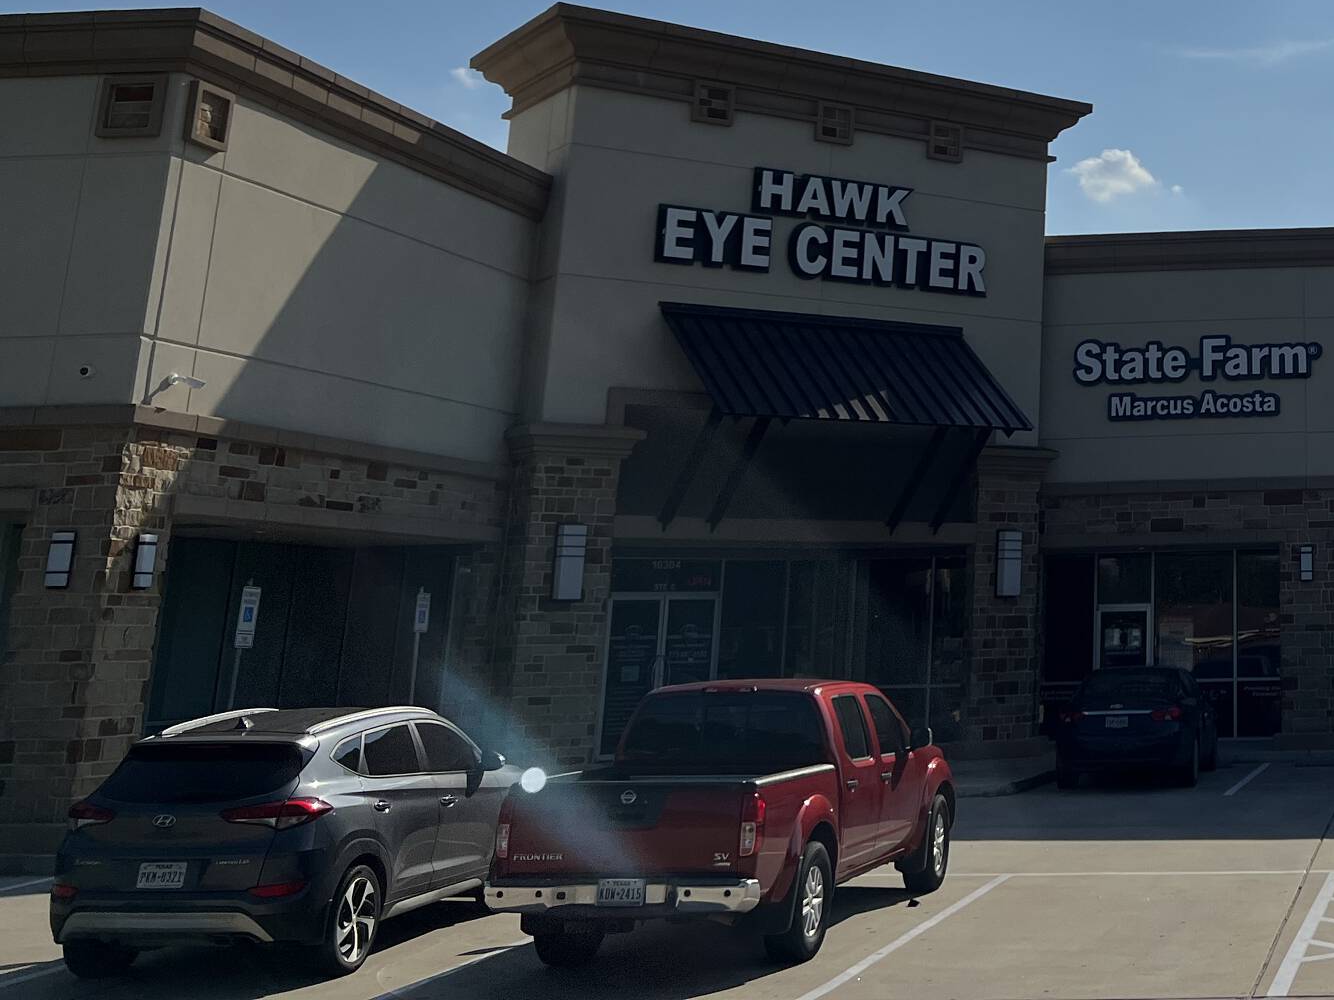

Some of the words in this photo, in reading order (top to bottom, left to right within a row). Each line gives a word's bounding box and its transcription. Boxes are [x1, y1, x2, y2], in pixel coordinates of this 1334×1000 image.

[759, 170, 910, 227] HAWK
[662, 207, 773, 268] EYE
[795, 224, 987, 293] CENTER
[1076, 341, 1188, 382] State
[1110, 396, 1194, 417] Marcus
[1200, 392, 1276, 414] Acosta
[513, 853, 565, 861] FRONTIER
[713, 853, 729, 861] SV
